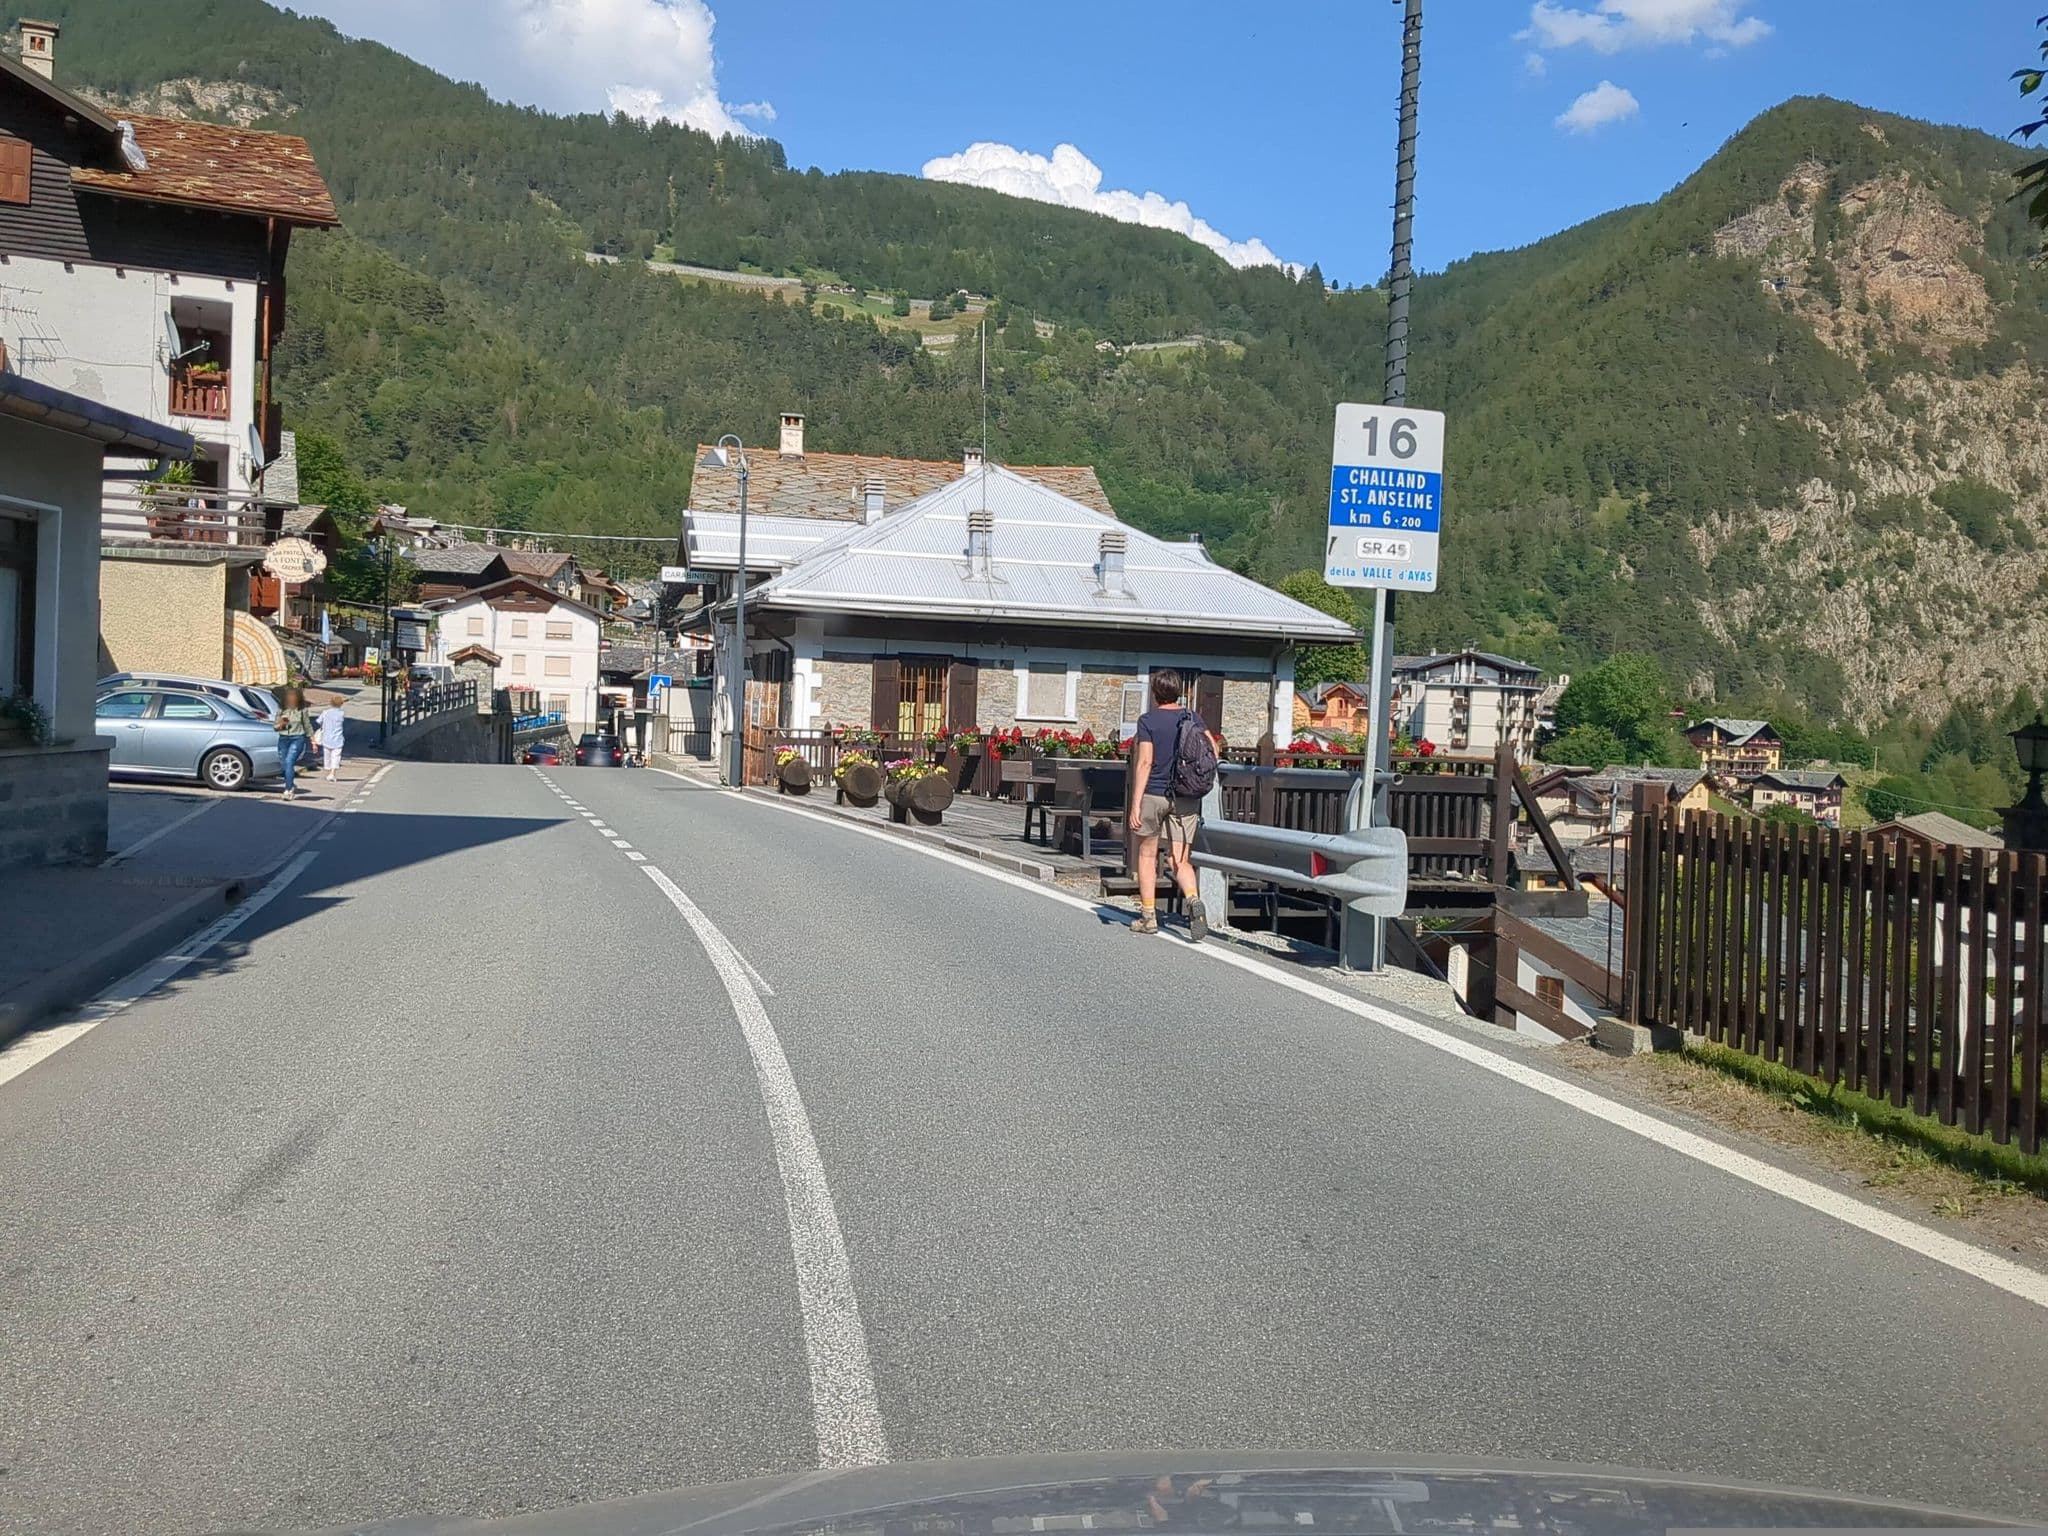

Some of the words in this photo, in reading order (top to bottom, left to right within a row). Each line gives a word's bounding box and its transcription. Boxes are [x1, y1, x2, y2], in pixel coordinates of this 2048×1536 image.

[1362, 416, 1417, 459] 16
[1349, 469, 1426, 490] CHALLAND
[1340, 488, 1362, 504] ST.
[1367, 489, 1433, 510] ANSELME
[1349, 508, 1371, 524] km
[1362, 542, 1382, 554] SR
[1387, 544, 1407, 557] 45
[664, 571, 715, 580] CARABINIERI
[1329, 567, 1356, 577] della
[1362, 567, 1393, 579] VALLE
[1398, 569, 1432, 582] d'AYAS
